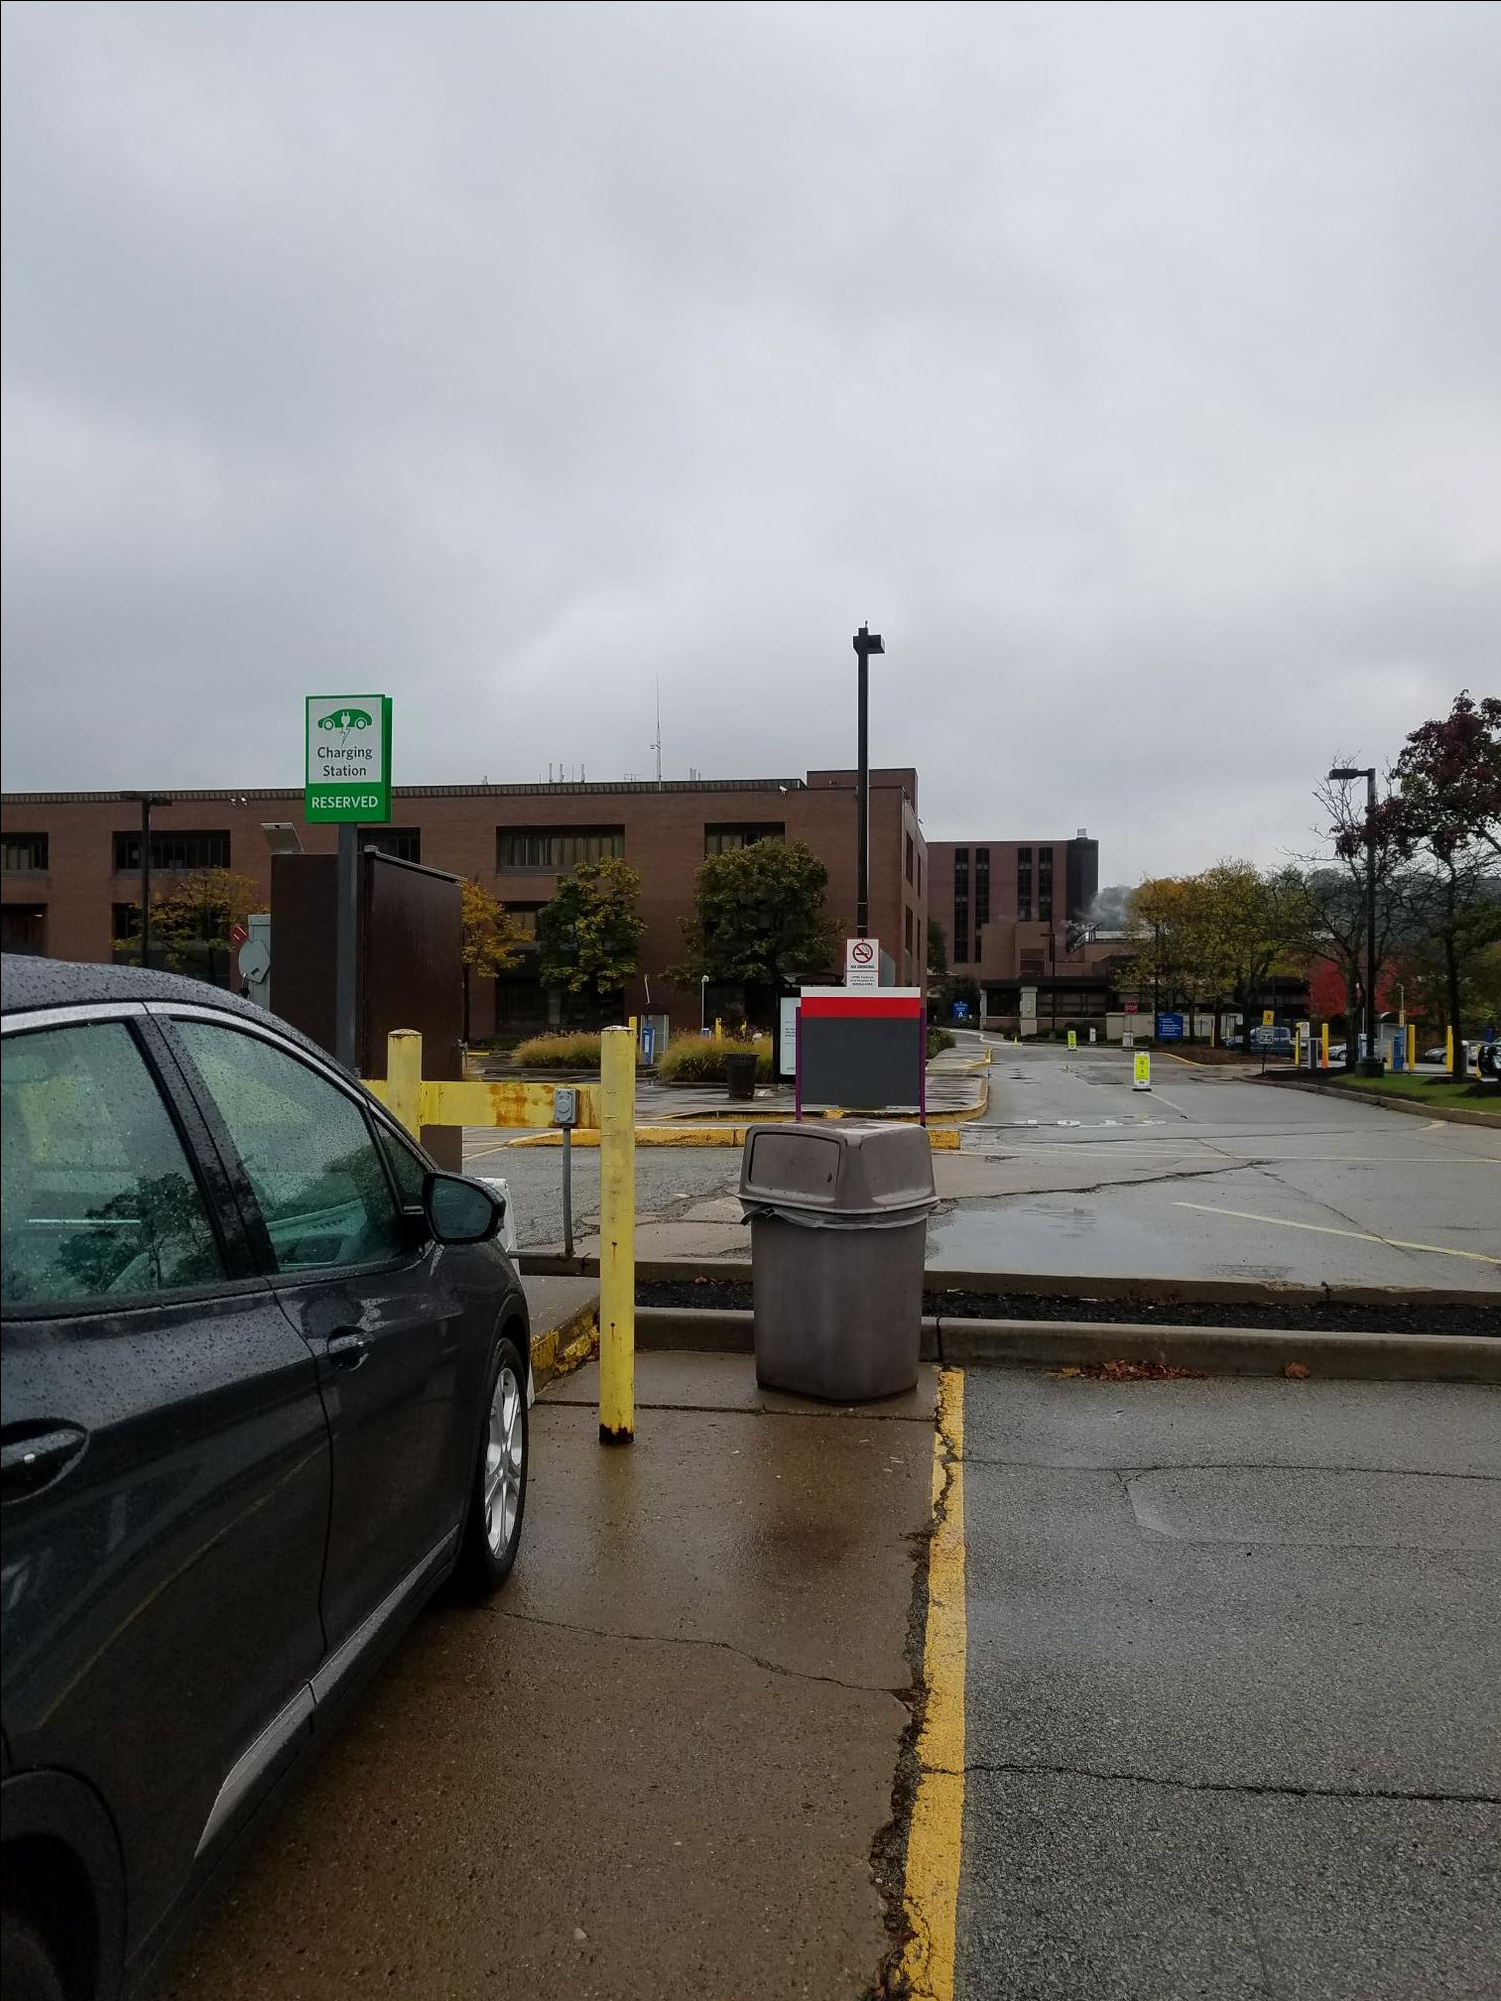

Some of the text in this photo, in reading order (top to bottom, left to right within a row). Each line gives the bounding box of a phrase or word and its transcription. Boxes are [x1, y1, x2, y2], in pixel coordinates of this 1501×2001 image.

[317, 745, 373, 760] Charging
[323, 764, 367, 777] Station
[311, 796, 379, 809] RESERVED
[1260, 1034, 1273, 1043] 25
